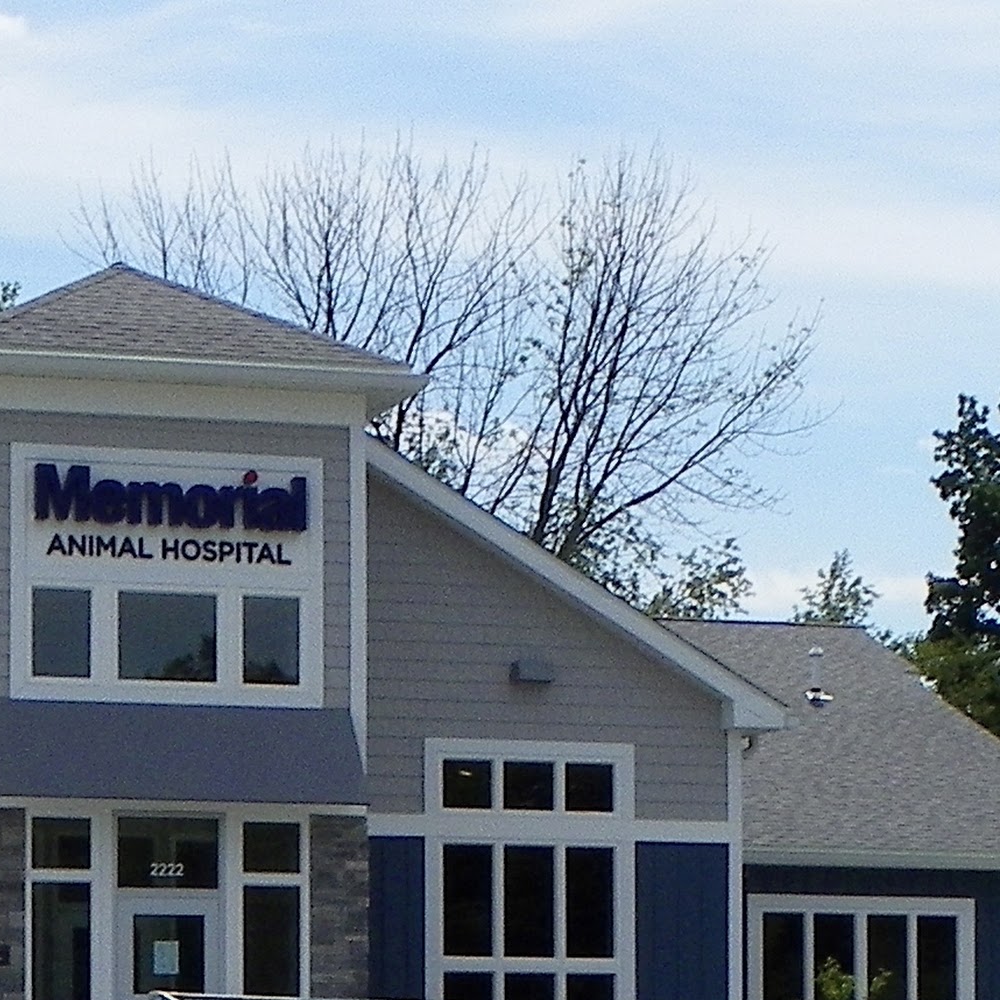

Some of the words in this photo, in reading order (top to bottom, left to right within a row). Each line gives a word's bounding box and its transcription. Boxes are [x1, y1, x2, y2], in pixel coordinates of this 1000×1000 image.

[34, 463, 307, 531] Memorial
[46, 533, 153, 559] ANIMAL
[161, 538, 292, 565] HOSPITAL
[150, 862, 184, 877] 2222
